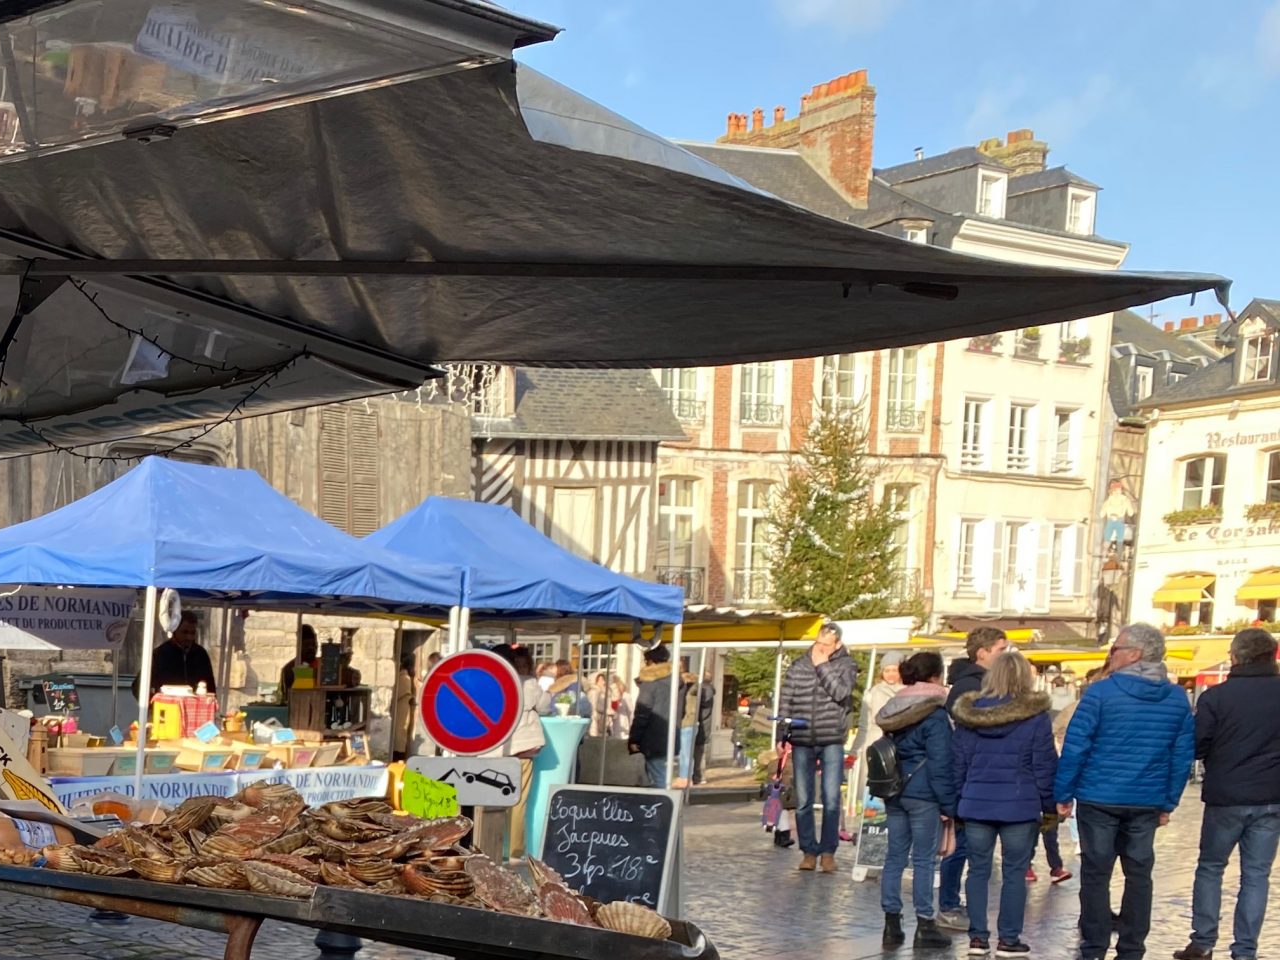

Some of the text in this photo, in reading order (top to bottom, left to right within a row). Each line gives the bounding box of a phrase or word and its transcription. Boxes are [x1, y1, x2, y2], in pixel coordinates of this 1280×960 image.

[18, 595, 40, 612] DE
[43, 595, 135, 619] NORMANDIE
[22, 617, 36, 629] DU
[37, 617, 103, 630] PRODUCTEUR
[295, 771, 379, 790] DE NORMANDIE
[148, 782, 229, 799] NORMANDIE
[556, 827, 630, 857] Jacques
